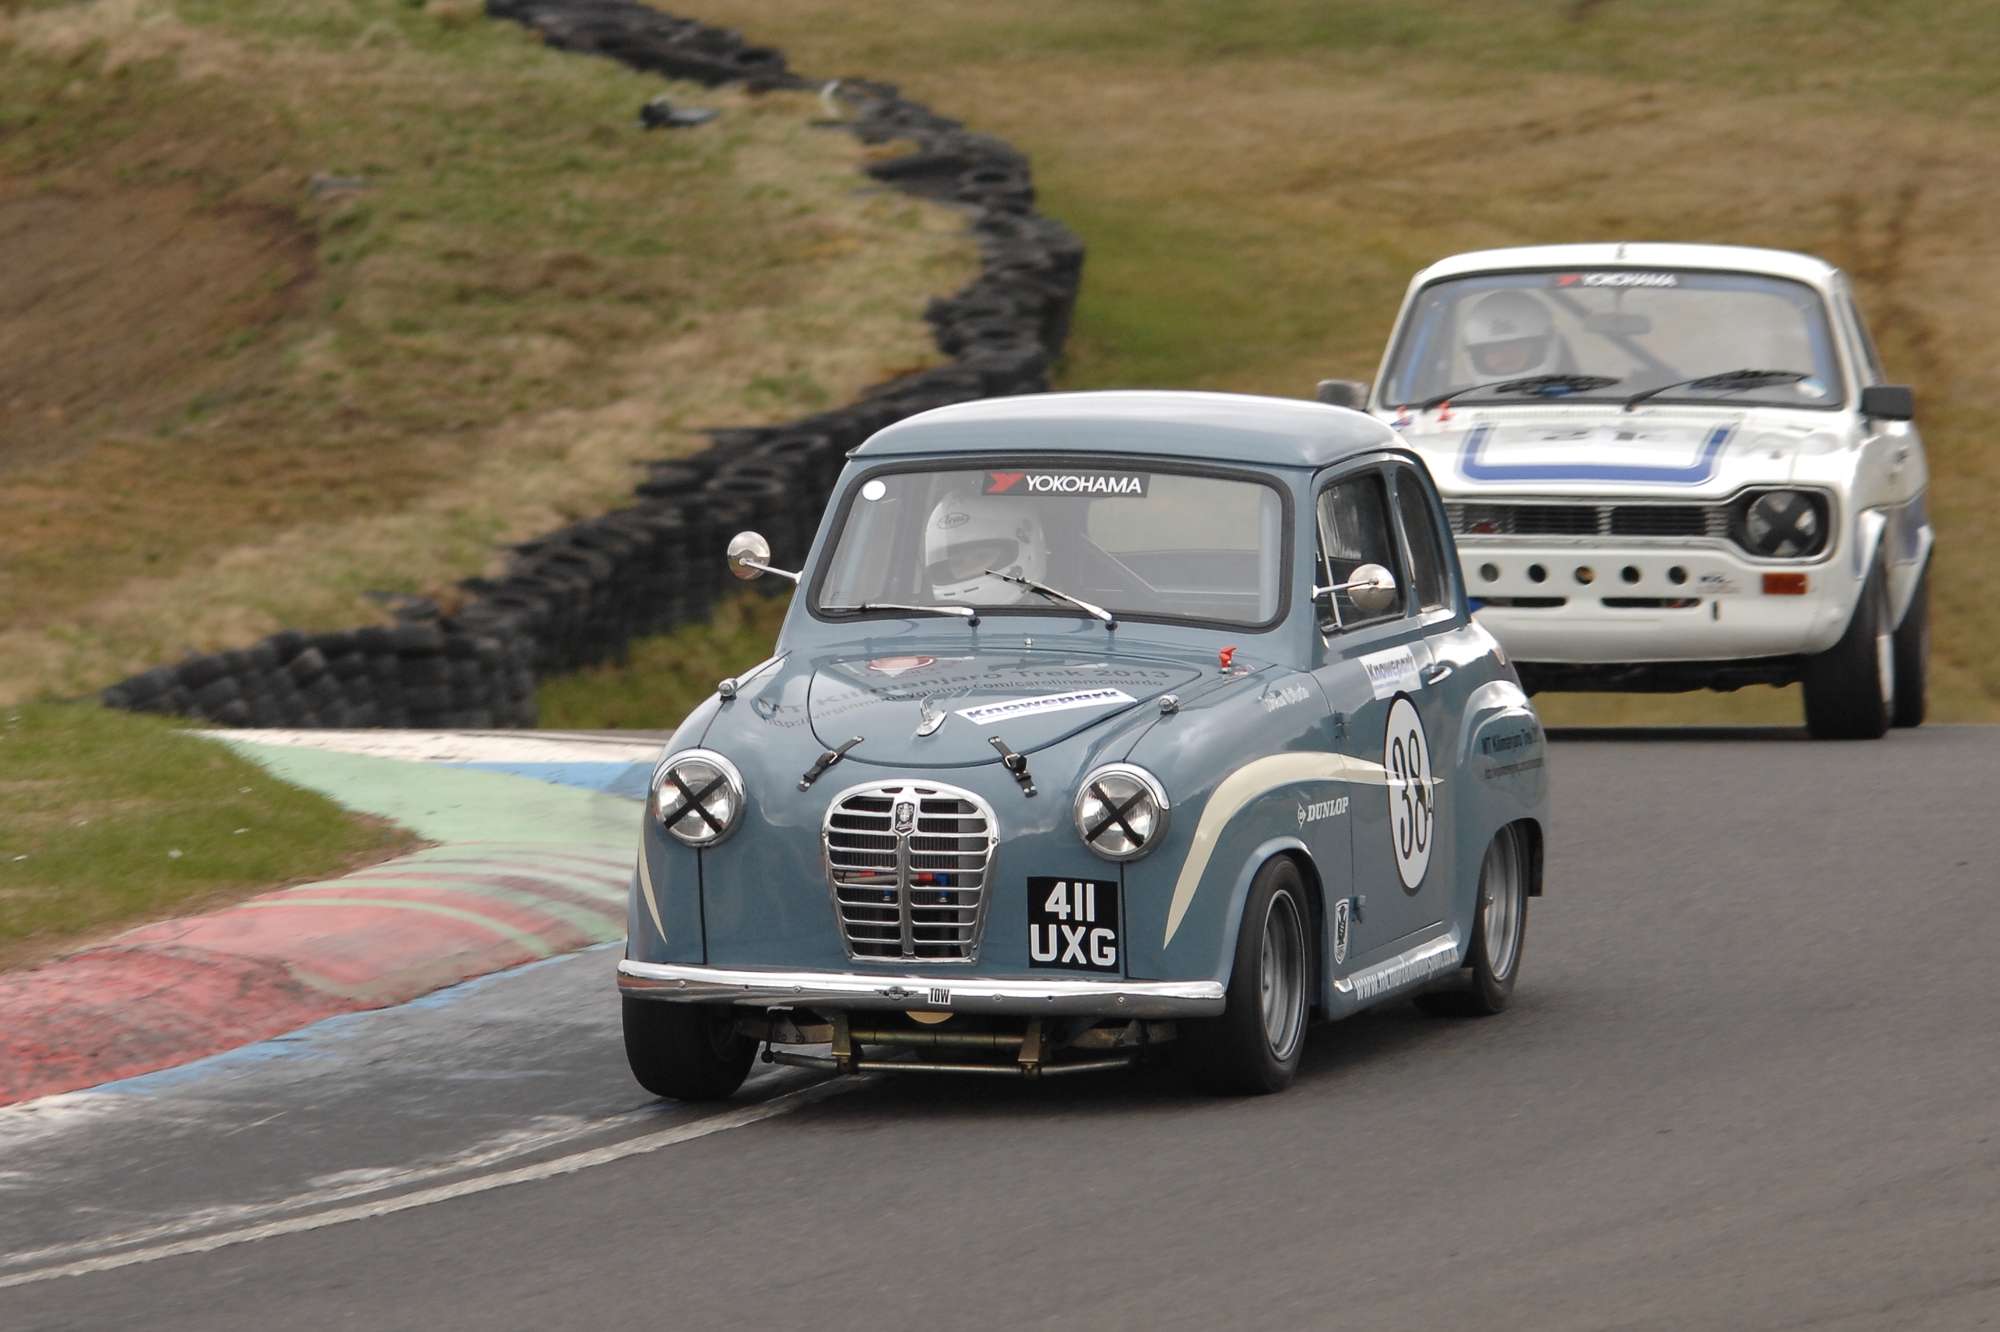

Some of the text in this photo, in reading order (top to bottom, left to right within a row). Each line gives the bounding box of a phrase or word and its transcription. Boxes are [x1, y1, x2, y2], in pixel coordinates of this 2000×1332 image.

[1025, 474, 1142, 494] YOKOHAMA
[1014, 668, 1085, 678] Trek
[1094, 669, 1171, 679] 2013
[966, 689, 1120, 719] Knowepark
[1393, 729, 1427, 860] 38
[1307, 796, 1350, 822] DUNLOP
[1045, 881, 1095, 922] 411
[1030, 923, 1117, 967] UXG
[930, 988, 950, 1003] TOW
